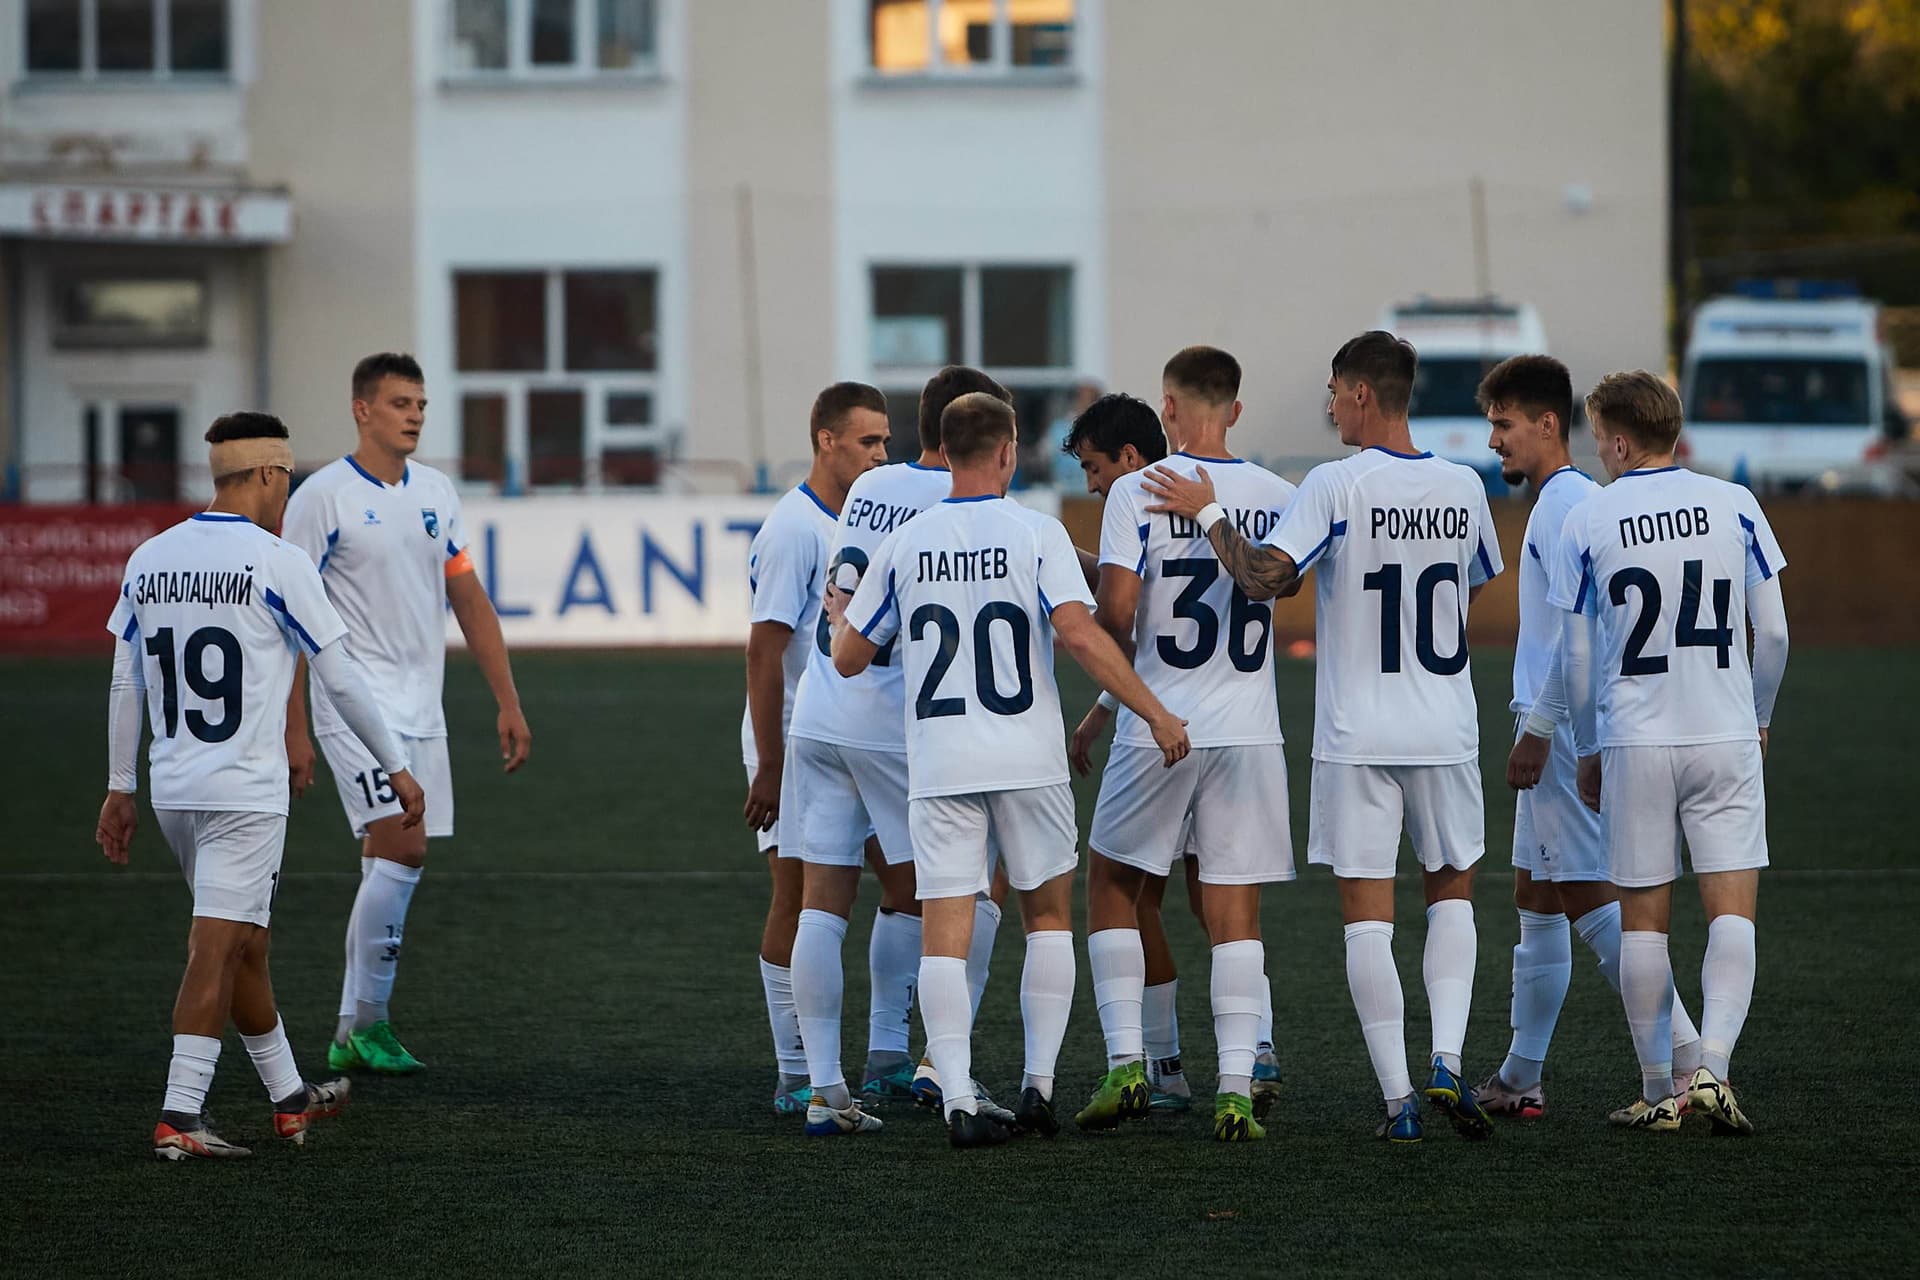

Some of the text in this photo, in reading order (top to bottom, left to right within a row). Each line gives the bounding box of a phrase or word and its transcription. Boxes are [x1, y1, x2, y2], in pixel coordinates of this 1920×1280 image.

[847, 498, 924, 534] ЕРОХИ
[1168, 507, 1283, 539] ШКО
[1370, 506, 1470, 541] РОЖКОВ
[1618, 506, 1711, 549] ПОПОВ
[136, 564, 255, 610] ЗАПАЛАЦКИЙ
[446, 519, 765, 616] LAN
[916, 547, 1009, 584] ЛАПТЕВ
[1157, 557, 1272, 673] 36
[1363, 562, 1470, 676] 10
[1608, 559, 1734, 677] 24
[909, 601, 1035, 721] 20
[145, 626, 244, 744] 19
[355, 767, 398, 809] 15
